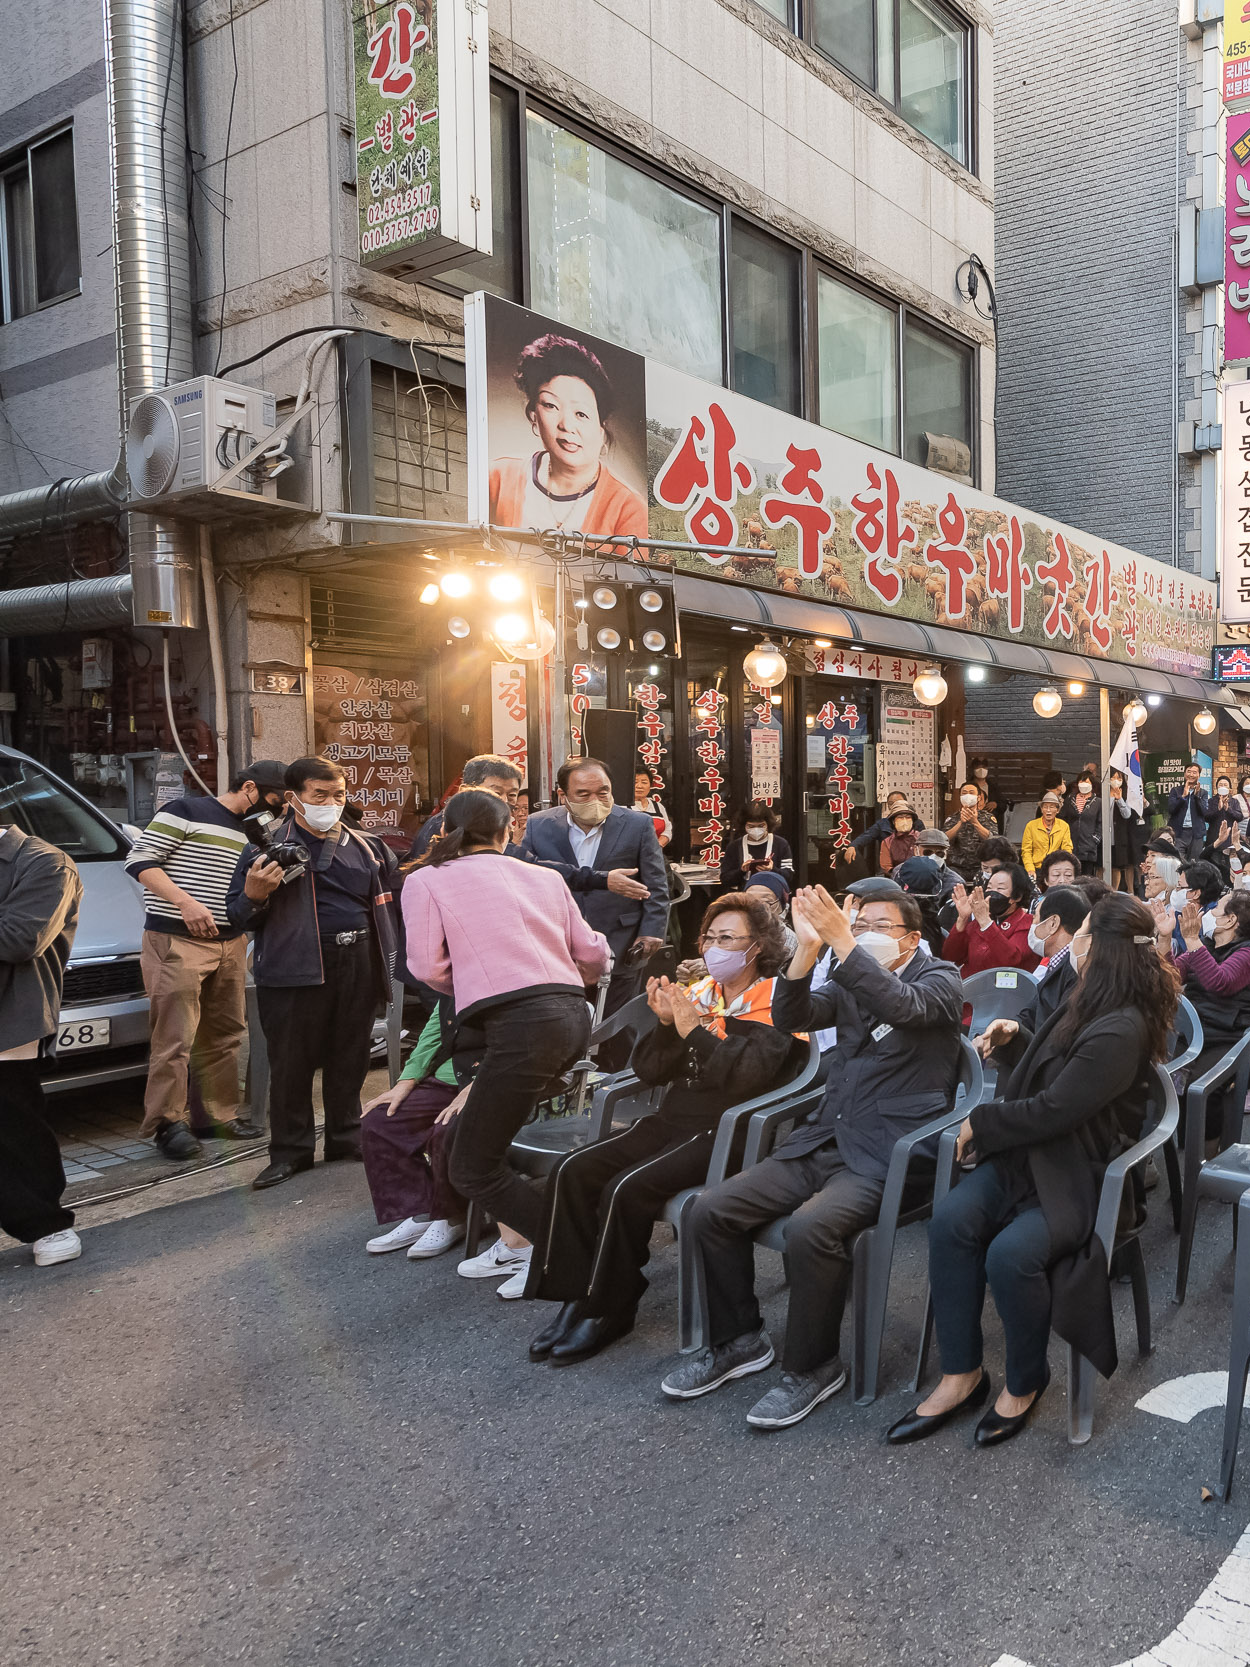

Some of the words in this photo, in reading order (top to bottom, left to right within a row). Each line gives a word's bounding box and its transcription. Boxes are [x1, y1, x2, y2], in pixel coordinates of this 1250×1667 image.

[370, 8, 425, 94] 간
[1226, 61, 1250, 80] 국내산
[1226, 80, 1250, 98] 전문점
[368, 186, 431, 225] 02.454.3517
[362, 208, 438, 248] 010.3757.2749
[173, 390, 203, 406] SAMSUNG
[659, 402, 1118, 650] 상주한우마굿간
[1143, 571, 1162, 604] 50년
[1123, 560, 1139, 657] 별관
[813, 649, 882, 678] 점심식사
[891, 659, 930, 681] 됩니
[266, 675, 288, 688] 38
[314, 675, 348, 693] 꽃살
[367, 678, 418, 698] 삼겹살
[340, 700, 392, 718] 안창살
[818, 701, 859, 731] 상주
[340, 722, 394, 741] 치맛살
[323, 744, 411, 762] 생고기모듬
[377, 766, 414, 784] 목살
[695, 688, 726, 868] 상주한우마굿간
[345, 788, 404, 806] 사시미
[753, 781, 778, 796] 냉방중
[362, 810, 398, 827] 등심
[58, 1025, 94, 1047] 68
